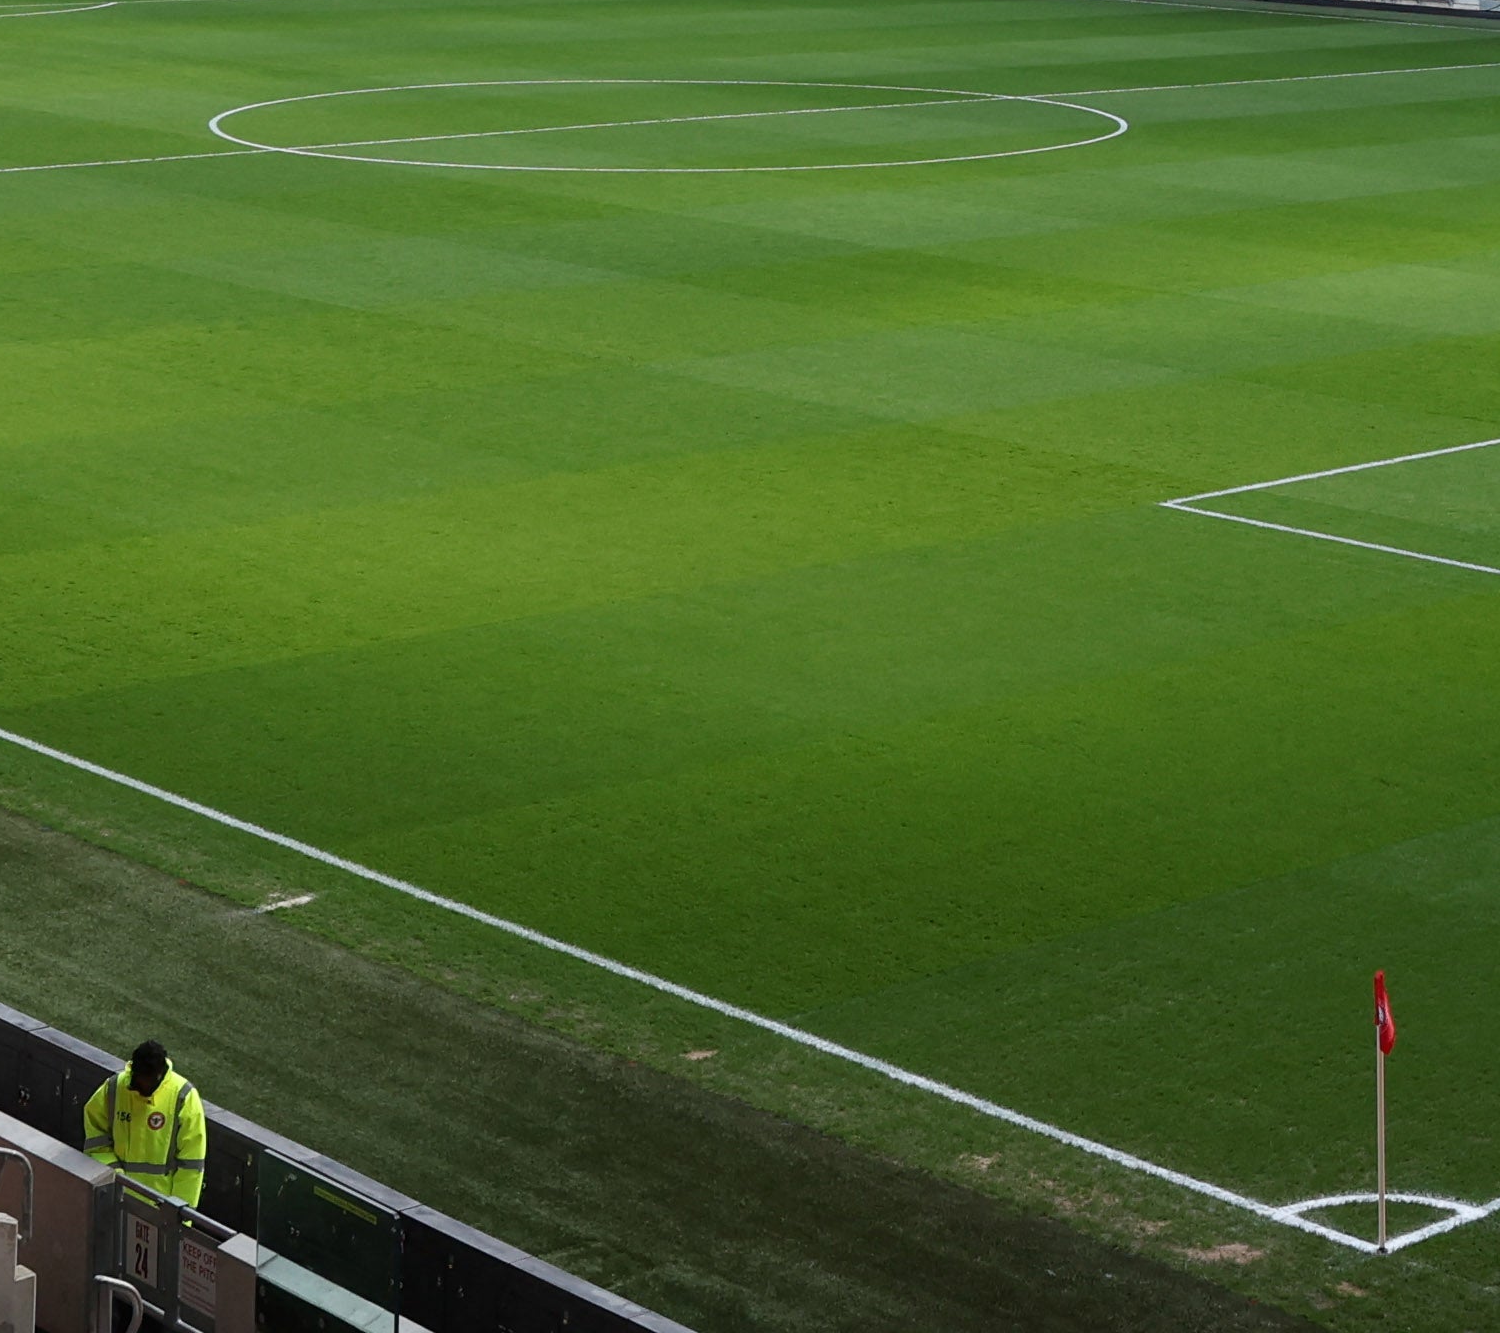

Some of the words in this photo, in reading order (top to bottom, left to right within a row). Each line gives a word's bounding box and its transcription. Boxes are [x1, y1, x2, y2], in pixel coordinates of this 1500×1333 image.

[135, 1220, 150, 1244] GATE
[134, 1242, 149, 1279] 24
[182, 1241, 202, 1259] KEEP
[182, 1256, 197, 1273] THE
